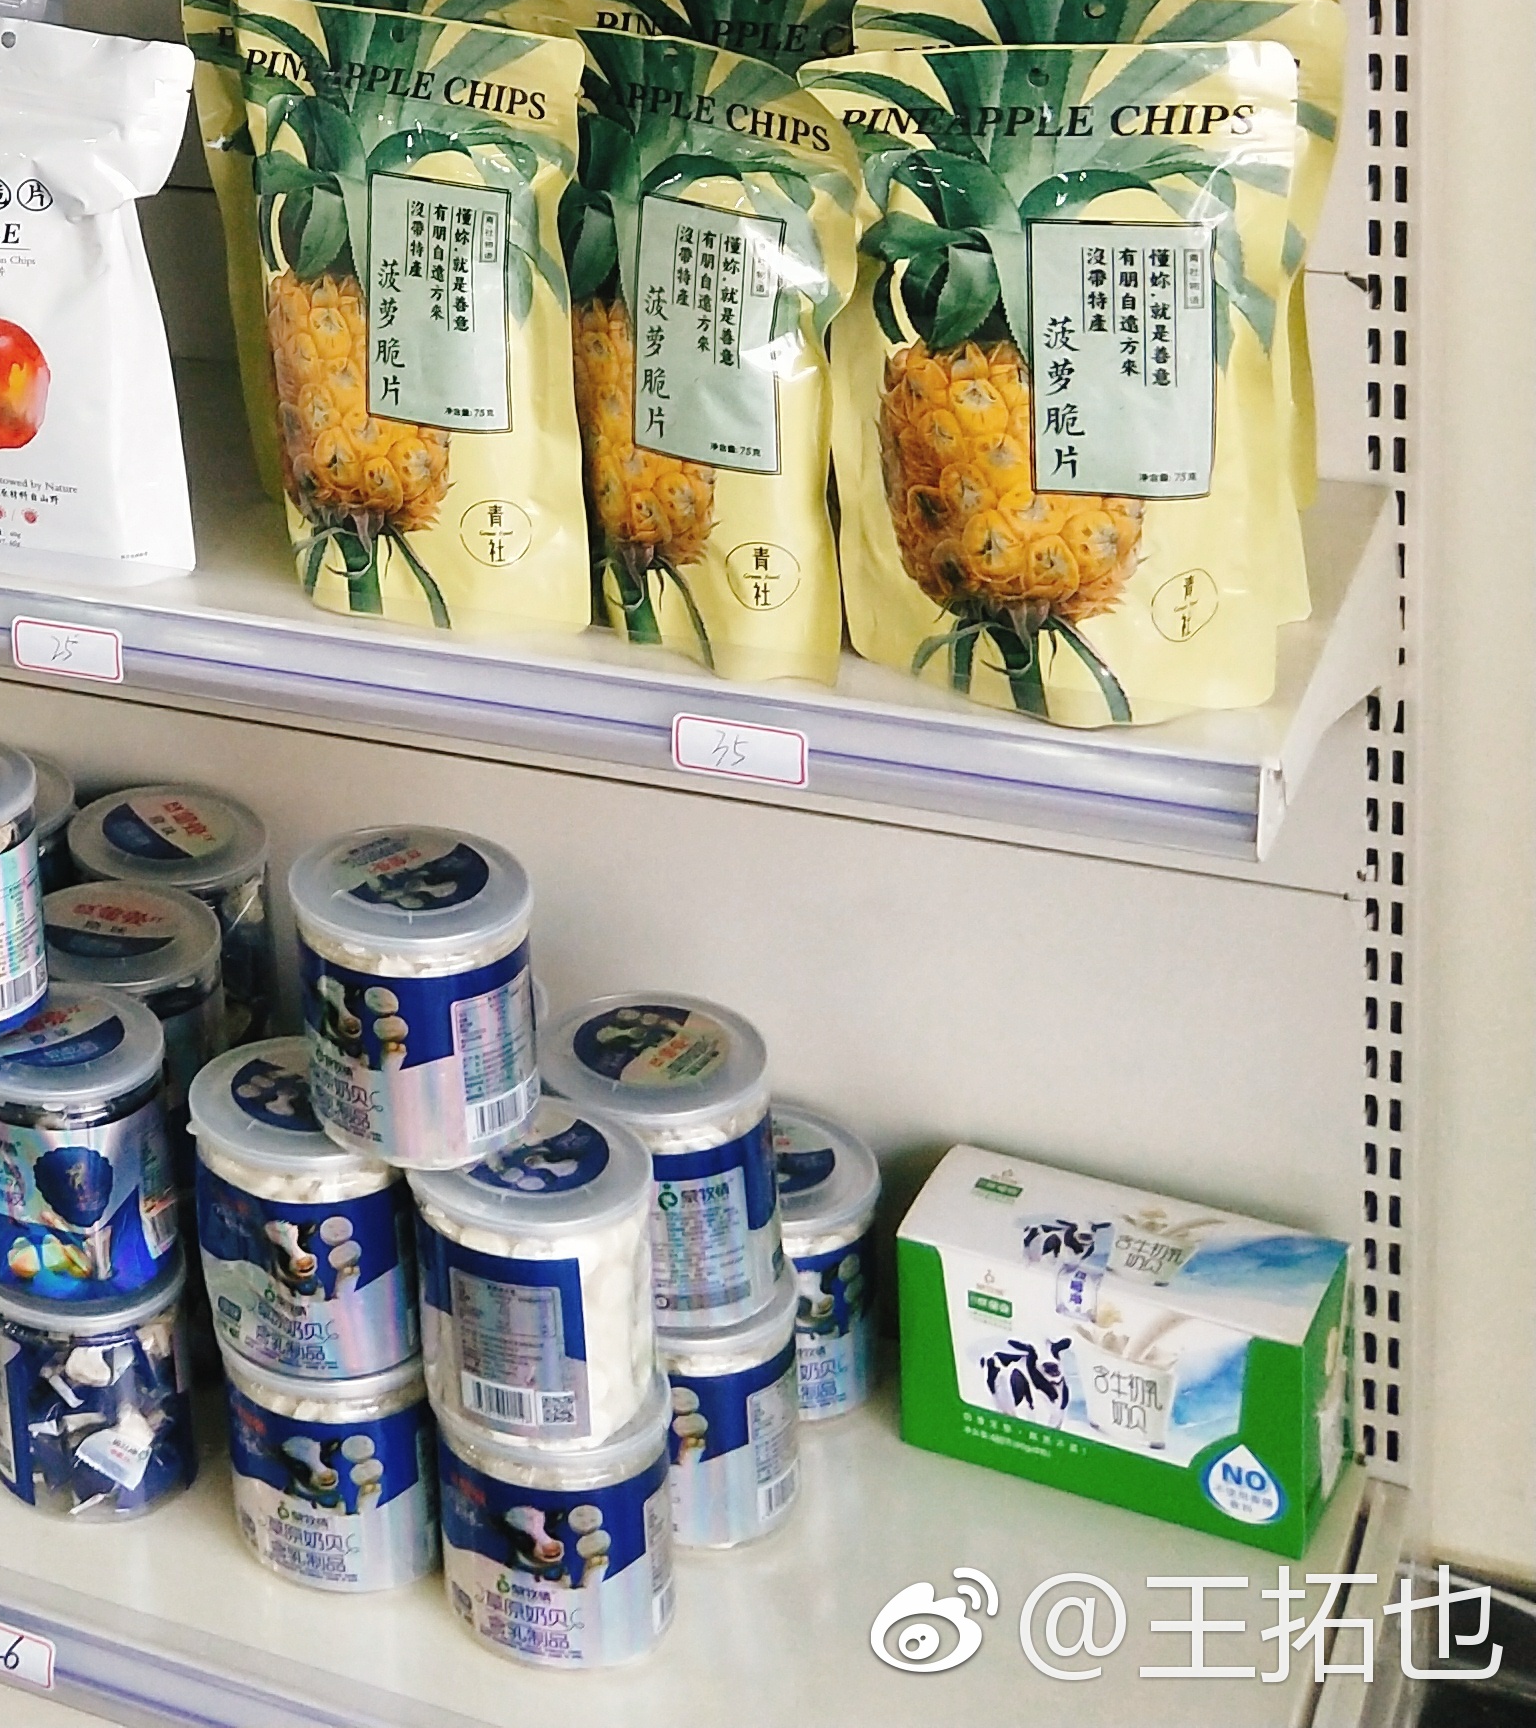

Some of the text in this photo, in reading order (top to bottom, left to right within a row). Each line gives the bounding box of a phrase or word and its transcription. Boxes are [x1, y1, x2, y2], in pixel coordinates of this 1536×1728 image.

[245, 46, 549, 122] PINEAPPLE CHIPS
[840, 103, 1255, 139] PINEAPPLE CHIPS
[726, 103, 830, 152] CHIPS
[409, 199, 426, 280] 沒帶特產
[429, 203, 448, 322] 有朋自遠方來
[675, 225, 694, 308] 沒帶特產
[373, 257, 408, 407] 菠萝脆片
[696, 230, 717, 353] 有朋自遠方來
[1086, 245, 1108, 334] 沒帶特產
[1117, 247, 1141, 378] 有朋自遠方來
[641, 284, 670, 440] 菠萝脆片
[1042, 315, 1087, 480] 菠萝脆片
[50, 633, 79, 662] 25
[1221, 1462, 1267, 1491] NO
